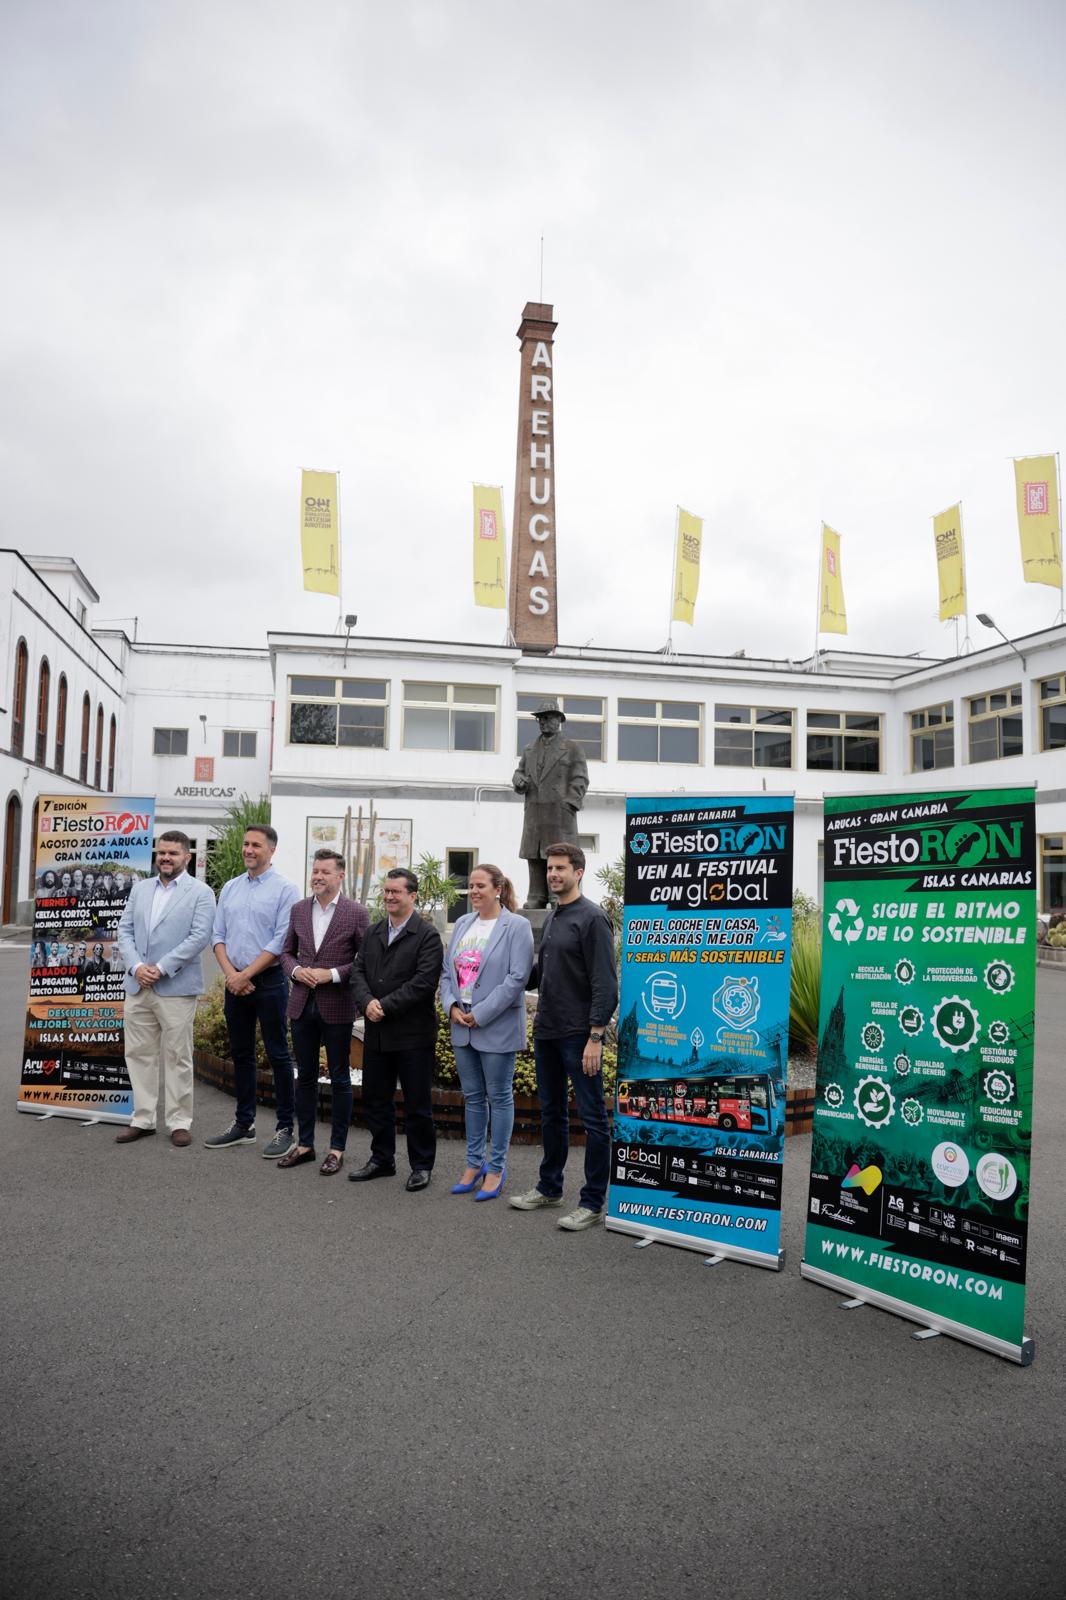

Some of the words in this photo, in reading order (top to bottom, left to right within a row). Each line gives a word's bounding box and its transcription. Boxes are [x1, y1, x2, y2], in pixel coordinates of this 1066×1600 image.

[528, 342, 552, 615] AREHUCAS
[174, 787, 234, 797] AREHUCAS
[54, 800, 87, 810] EDICIÓN
[630, 813, 662, 826] ARUCAS
[671, 812, 695, 823] GRAN
[697, 810, 736, 821] CANARIA
[827, 818, 862, 831] ARUCAS
[870, 811, 898, 825] GRAN
[901, 802, 949, 818] CANARIA
[40, 839, 78, 849] AGOSTO
[80, 838, 106, 848] 2024
[110, 837, 148, 846] ARUCAS
[55, 852, 82, 861] GRAN
[85, 850, 130, 860] CANARIA
[637, 865, 667, 880] VEN
[671, 864, 692, 878] AL
[697, 859, 778, 877] FESTIVAL
[923, 874, 956, 888] ISLAS
[961, 871, 1032, 888] CANARIAS
[650, 886, 683, 901] CON
[686, 878, 768, 907] global
[36, 898, 68, 907] VIERNES
[71, 897, 77, 906] 9
[111, 896, 128, 906] MECÁ
[36, 910, 59, 919] CELTAS
[61, 909, 90, 918] CORTOS
[872, 902, 919, 919] SIGUE
[926, 903, 946, 919] EL
[955, 901, 1020, 920] RITMO
[628, 919, 650, 931] CON
[652, 919, 665, 931] EL
[668, 918, 703, 931] COCHE
[705, 918, 722, 931] EN
[724, 918, 759, 932] CASA,
[627, 933, 643, 945] LO
[646, 929, 702, 945] PASARÁS
[707, 933, 754, 945] MEJOR
[866, 926, 887, 942] DE
[893, 926, 914, 942] LO
[921, 926, 1027, 944] SOSTENIBLE
[627, 953, 633, 962] Y
[635, 951, 666, 963] SERÁS
[669, 948, 697, 963] MÁS
[700, 950, 784, 963] SOSTENIBLE
[69, 966, 77, 975] 10
[86, 972, 105, 982] CAFÉ
[107, 974, 124, 982] QUIJA
[85, 992, 124, 1001] PIGNOISE
[48, 1008, 94, 1018] DESCUBRE
[99, 1008, 115, 1017] TUS
[29, 1020, 71, 1029] MEJORES
[75, 1020, 125, 1028] VACACION
[40, 1033, 64, 1042] ISLAS
[68, 1032, 120, 1042] CANARIAS
[980, 1047, 1006, 1056] GESTIÓN
[915, 1060, 944, 1068] IGUALDAD
[983, 1055, 1014, 1064] RESIDUOS
[24, 1091, 129, 1103] WWW.FIESTORON.COM
[816, 1109, 854, 1120] COMUNICACIÓN
[927, 1108, 960, 1118] MOVILIDAD
[1014, 1110, 1023, 1118] DE
[927, 1117, 966, 1127] TRANSPORTE
[983, 1115, 1018, 1125] EMISIONES
[617, 1146, 661, 1165] global
[715, 1147, 737, 1156] ISLAS
[739, 1149, 779, 1161] CANARIAS
[618, 1202, 768, 1232] WWW.FIESTORON.COM
[821, 1240, 1003, 1300] WWW.FIESTORON.COM
